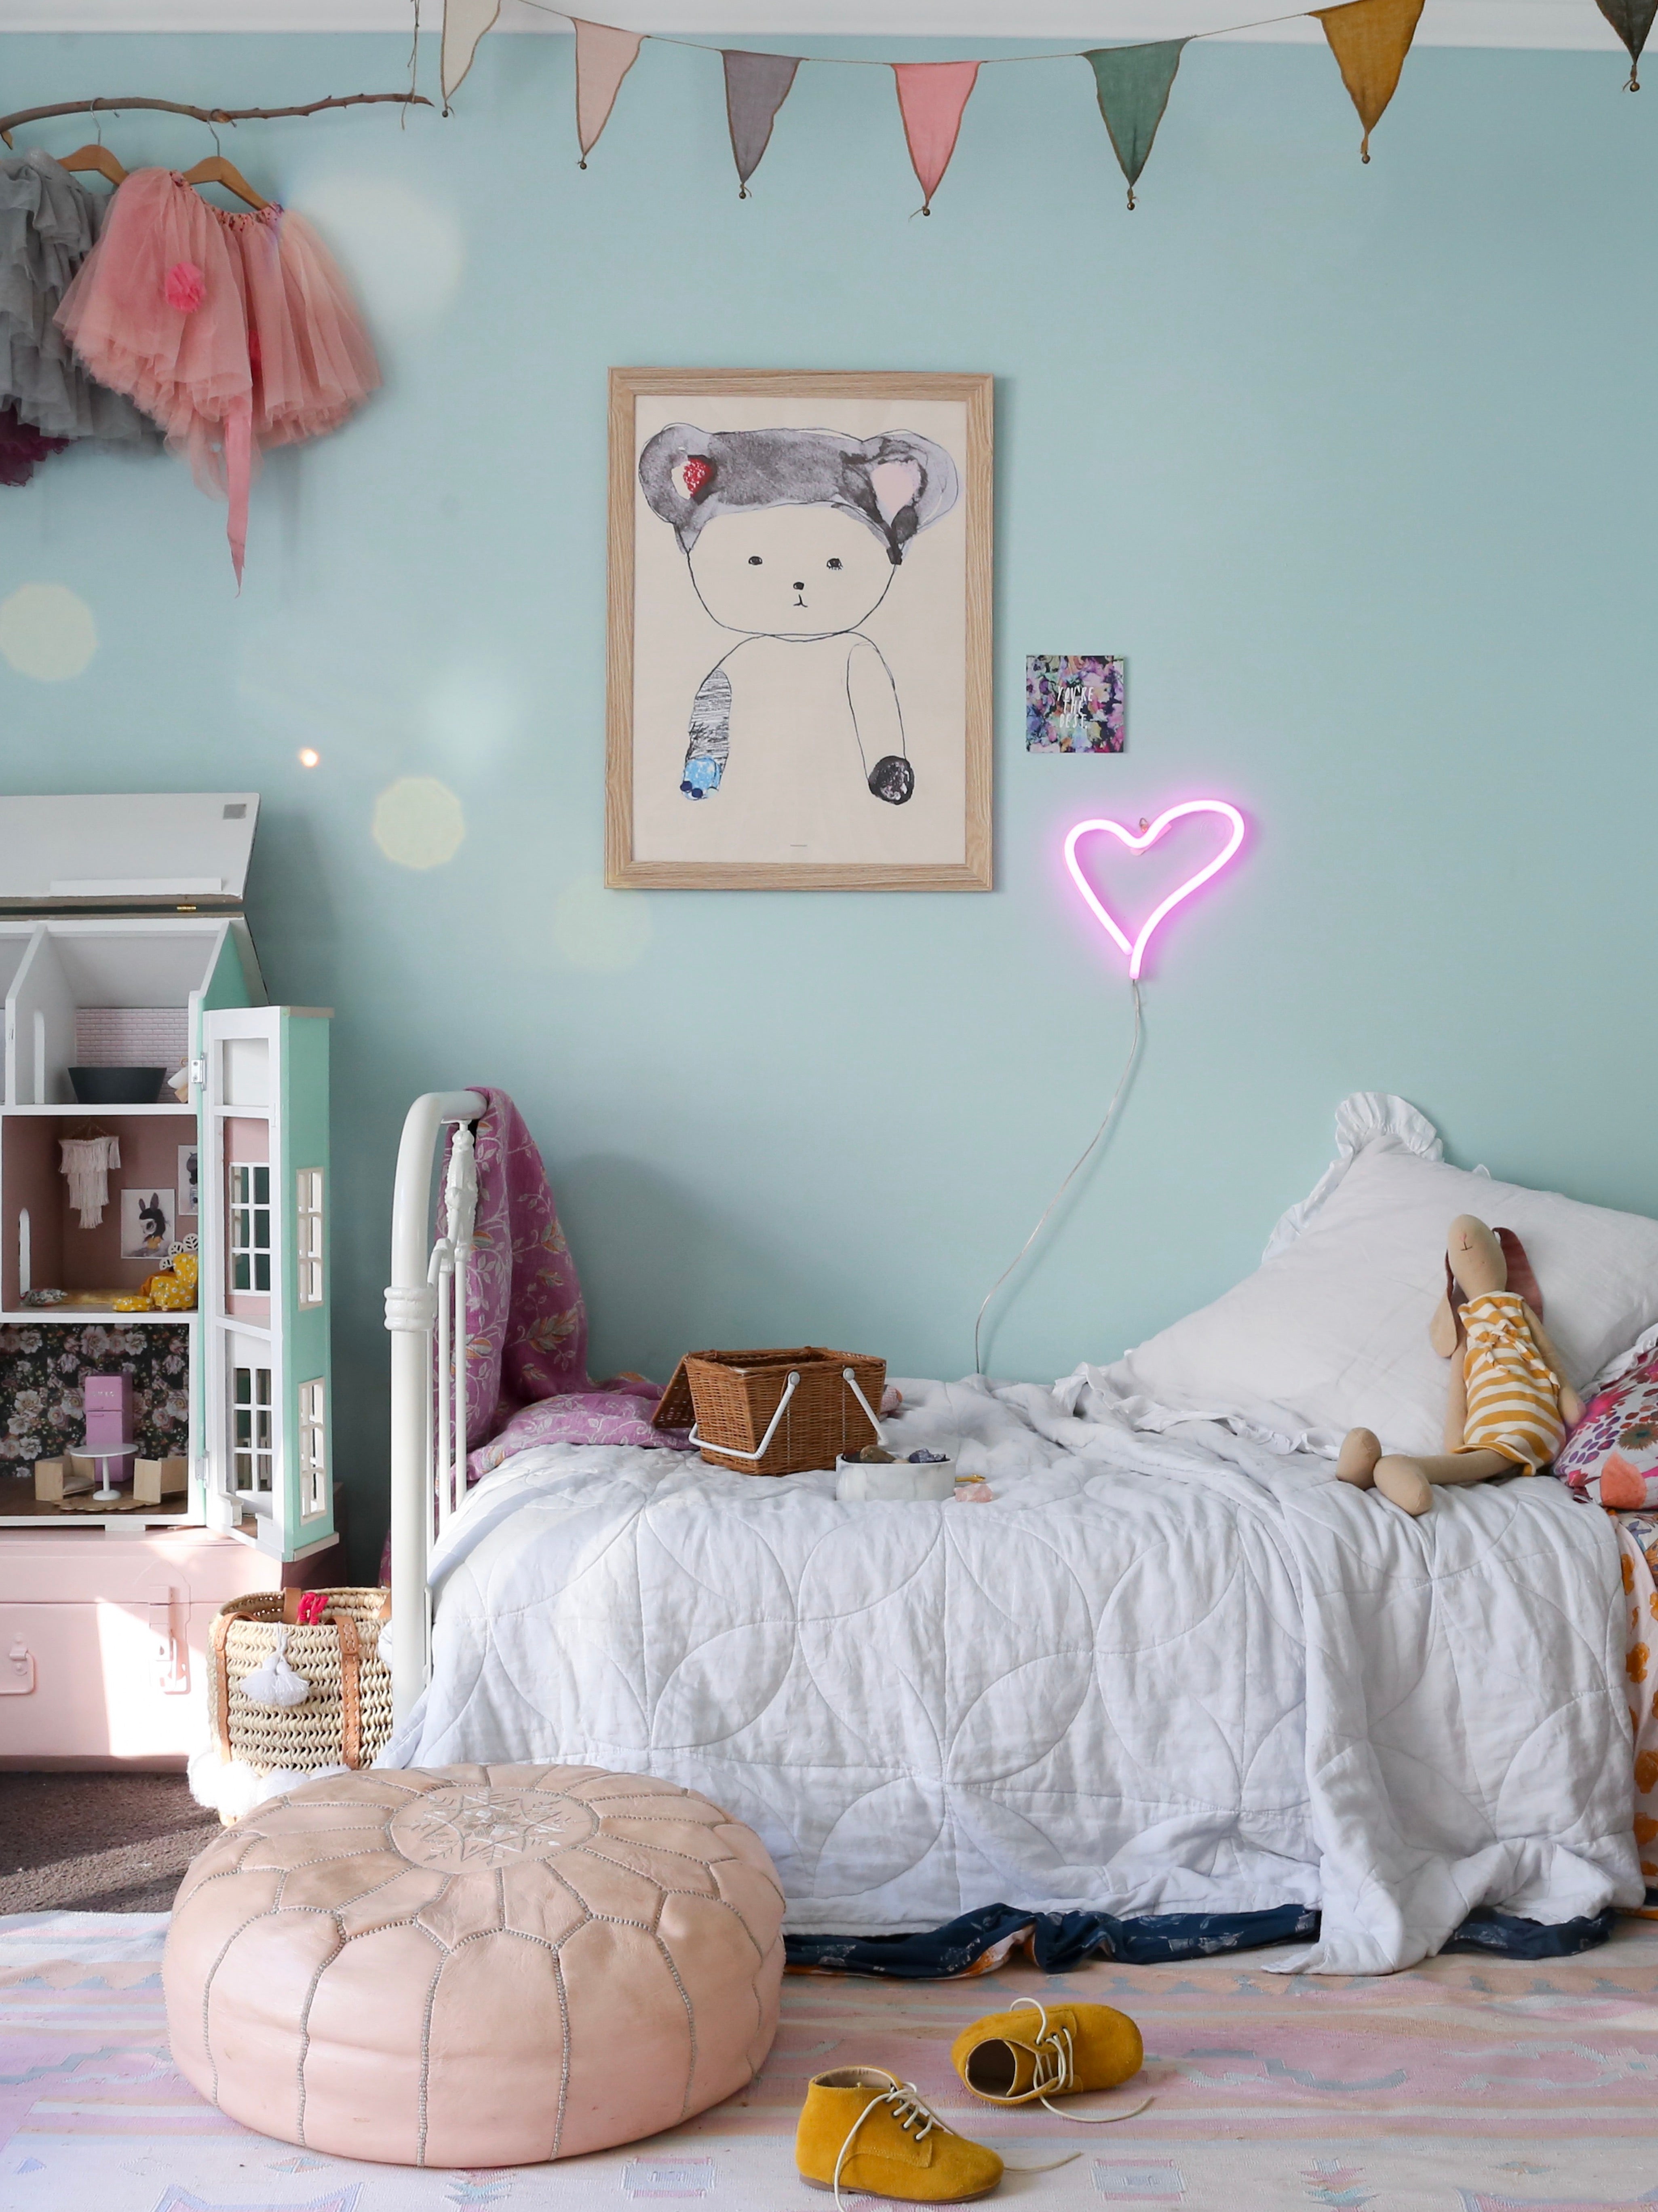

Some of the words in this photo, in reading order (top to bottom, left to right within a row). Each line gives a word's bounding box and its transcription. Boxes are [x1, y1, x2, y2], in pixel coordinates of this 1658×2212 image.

[1057, 686, 1094, 702] YOU'RE
[1063, 699, 1084, 714] THE
[1060, 713, 1087, 729] BEST.
